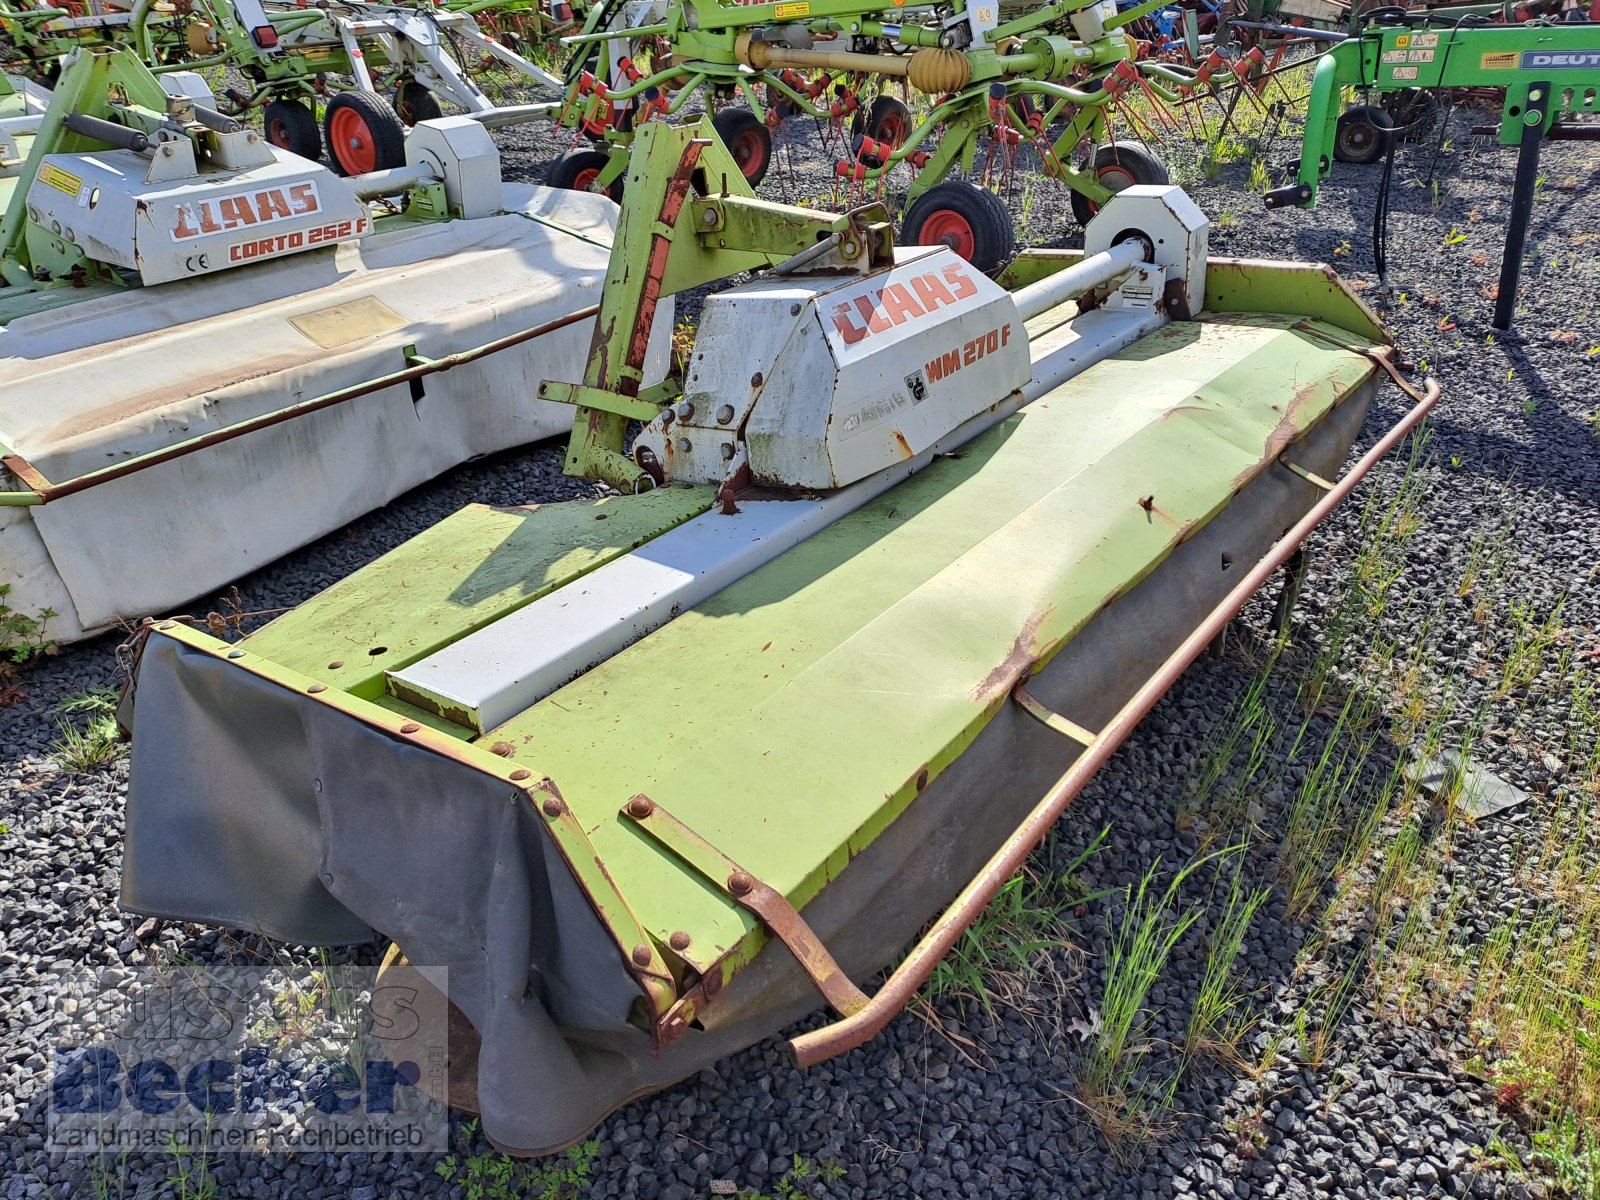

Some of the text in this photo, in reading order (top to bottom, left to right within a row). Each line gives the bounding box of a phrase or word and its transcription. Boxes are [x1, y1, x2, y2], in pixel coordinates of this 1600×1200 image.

[230, 217, 367, 262] CORTO 252 F
[830, 262, 978, 345] CLAAS
[924, 322, 1011, 384] WM 270 F
